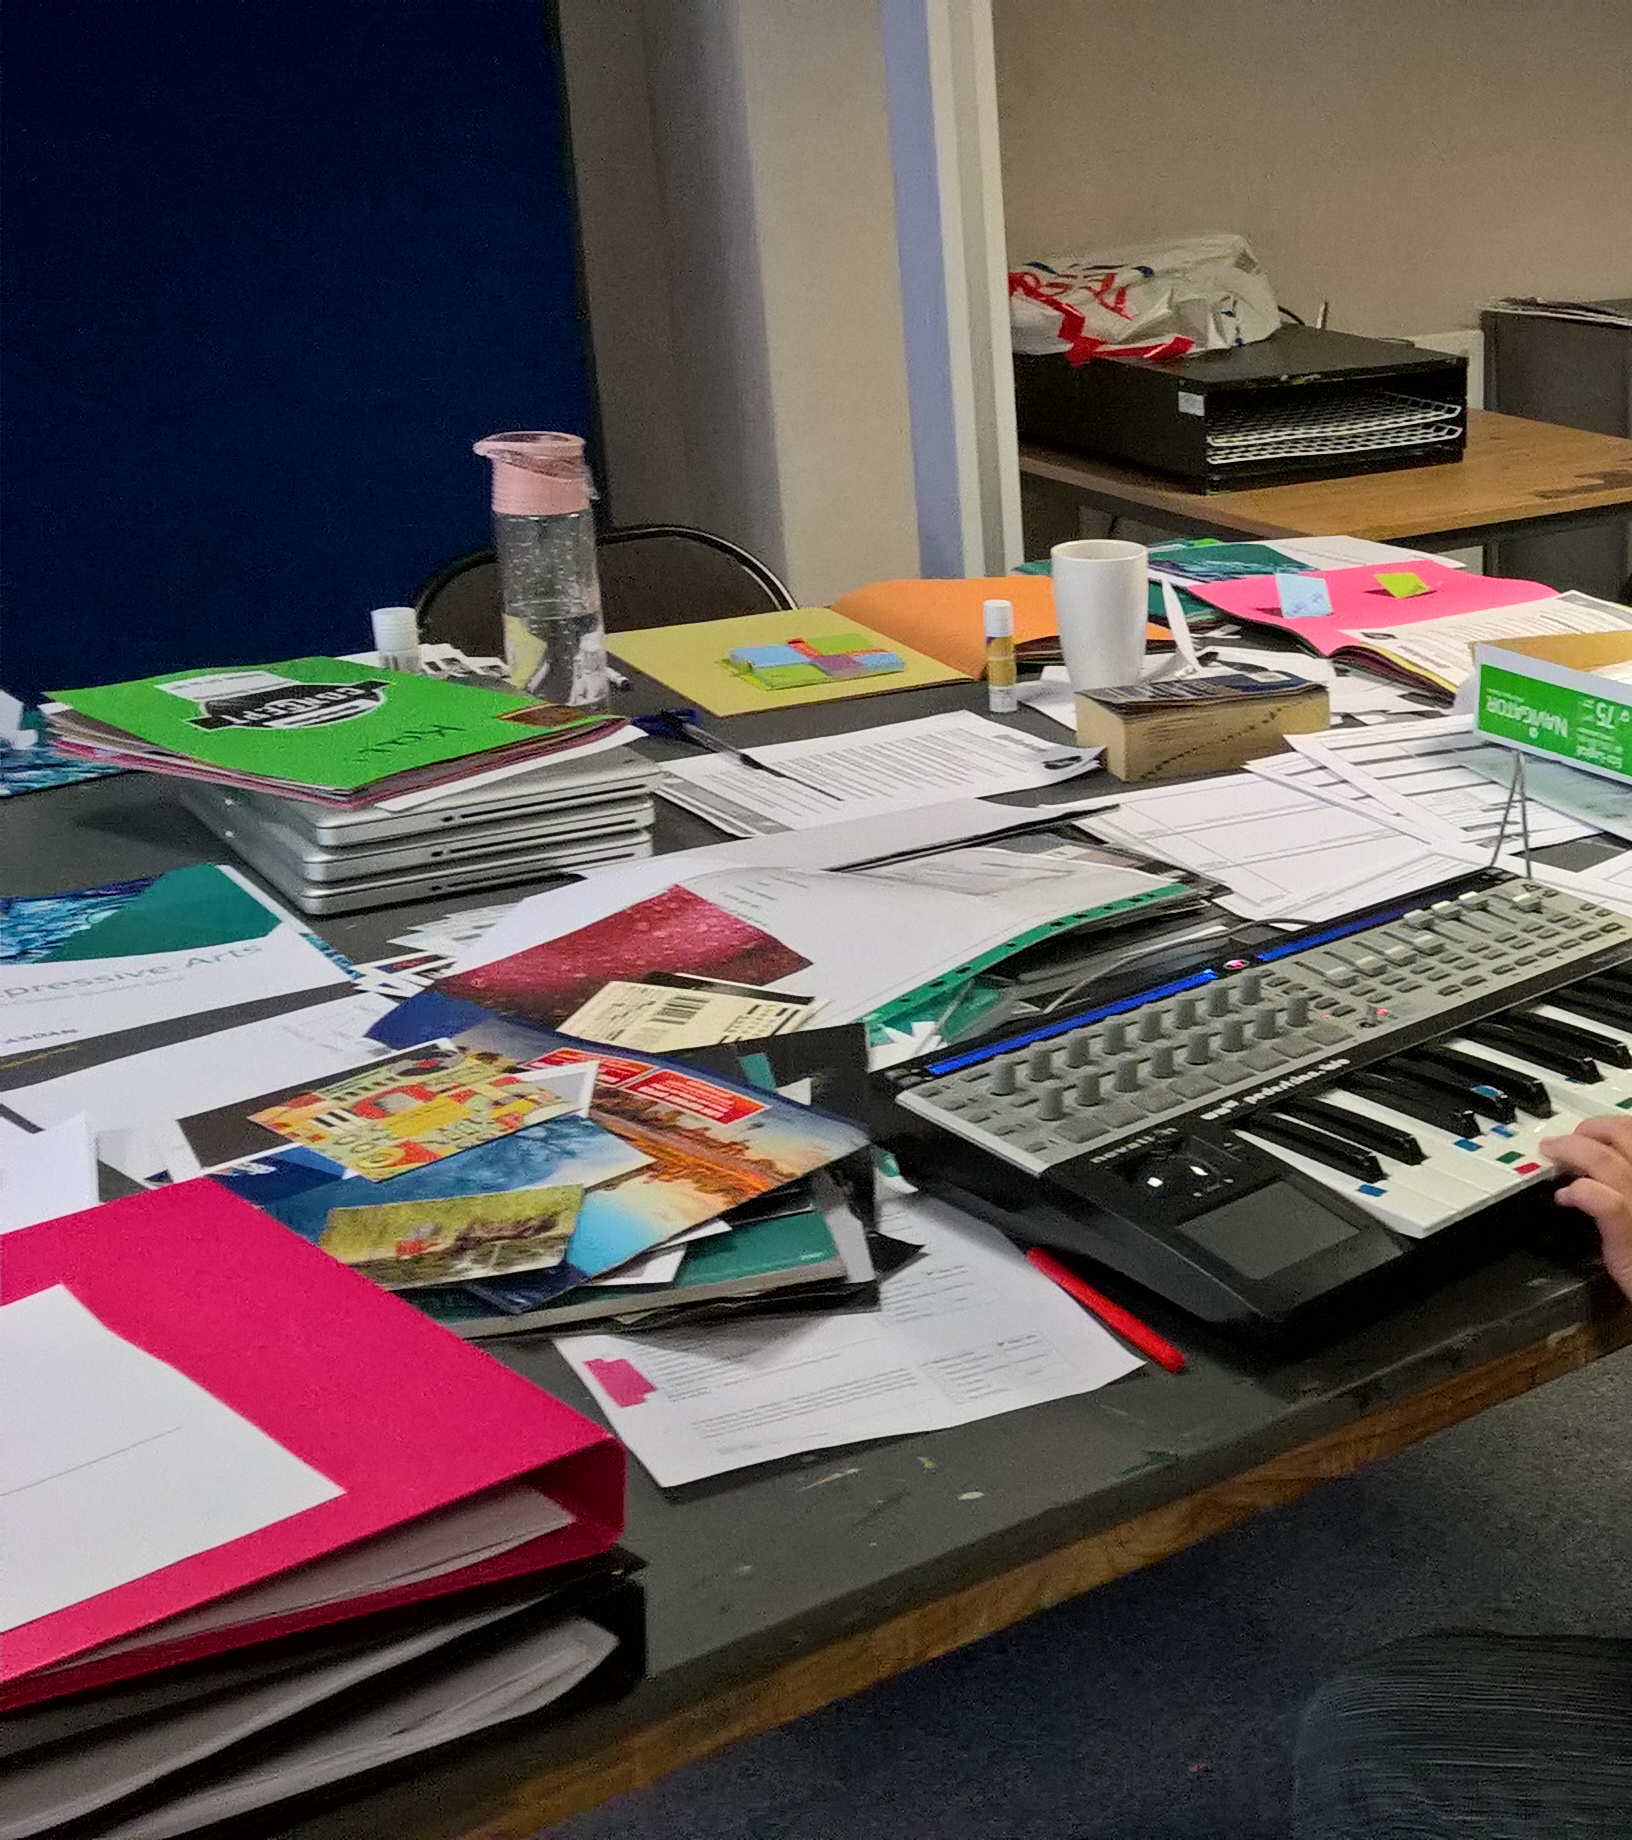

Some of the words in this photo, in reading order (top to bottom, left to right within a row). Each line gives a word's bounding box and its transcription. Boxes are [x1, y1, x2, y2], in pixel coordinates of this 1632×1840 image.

[220, 687, 367, 724] CONCEPT
[1485, 695, 1569, 739] NAVIGATOR
[0, 963, 172, 998] pressive
[185, 945, 263, 968] Arts
